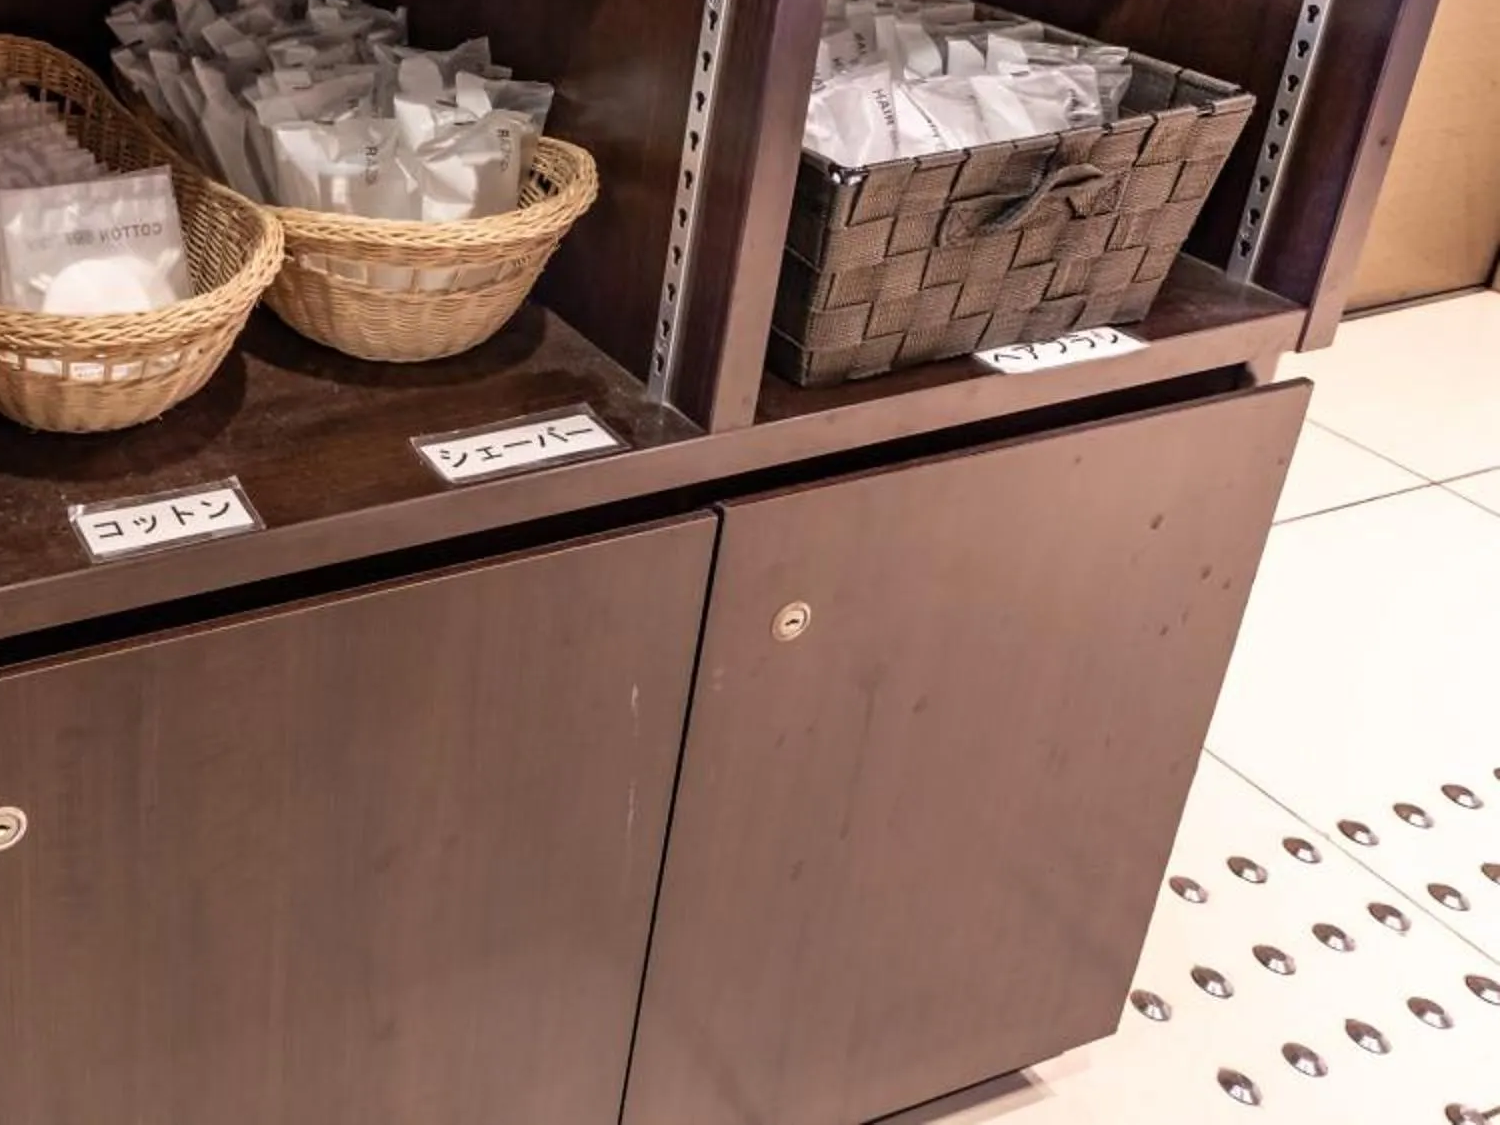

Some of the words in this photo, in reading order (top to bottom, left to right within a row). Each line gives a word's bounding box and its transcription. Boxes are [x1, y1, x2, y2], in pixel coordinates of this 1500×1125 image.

[439, 425, 595, 469] シェーバー
[93, 498, 231, 542] コットン
